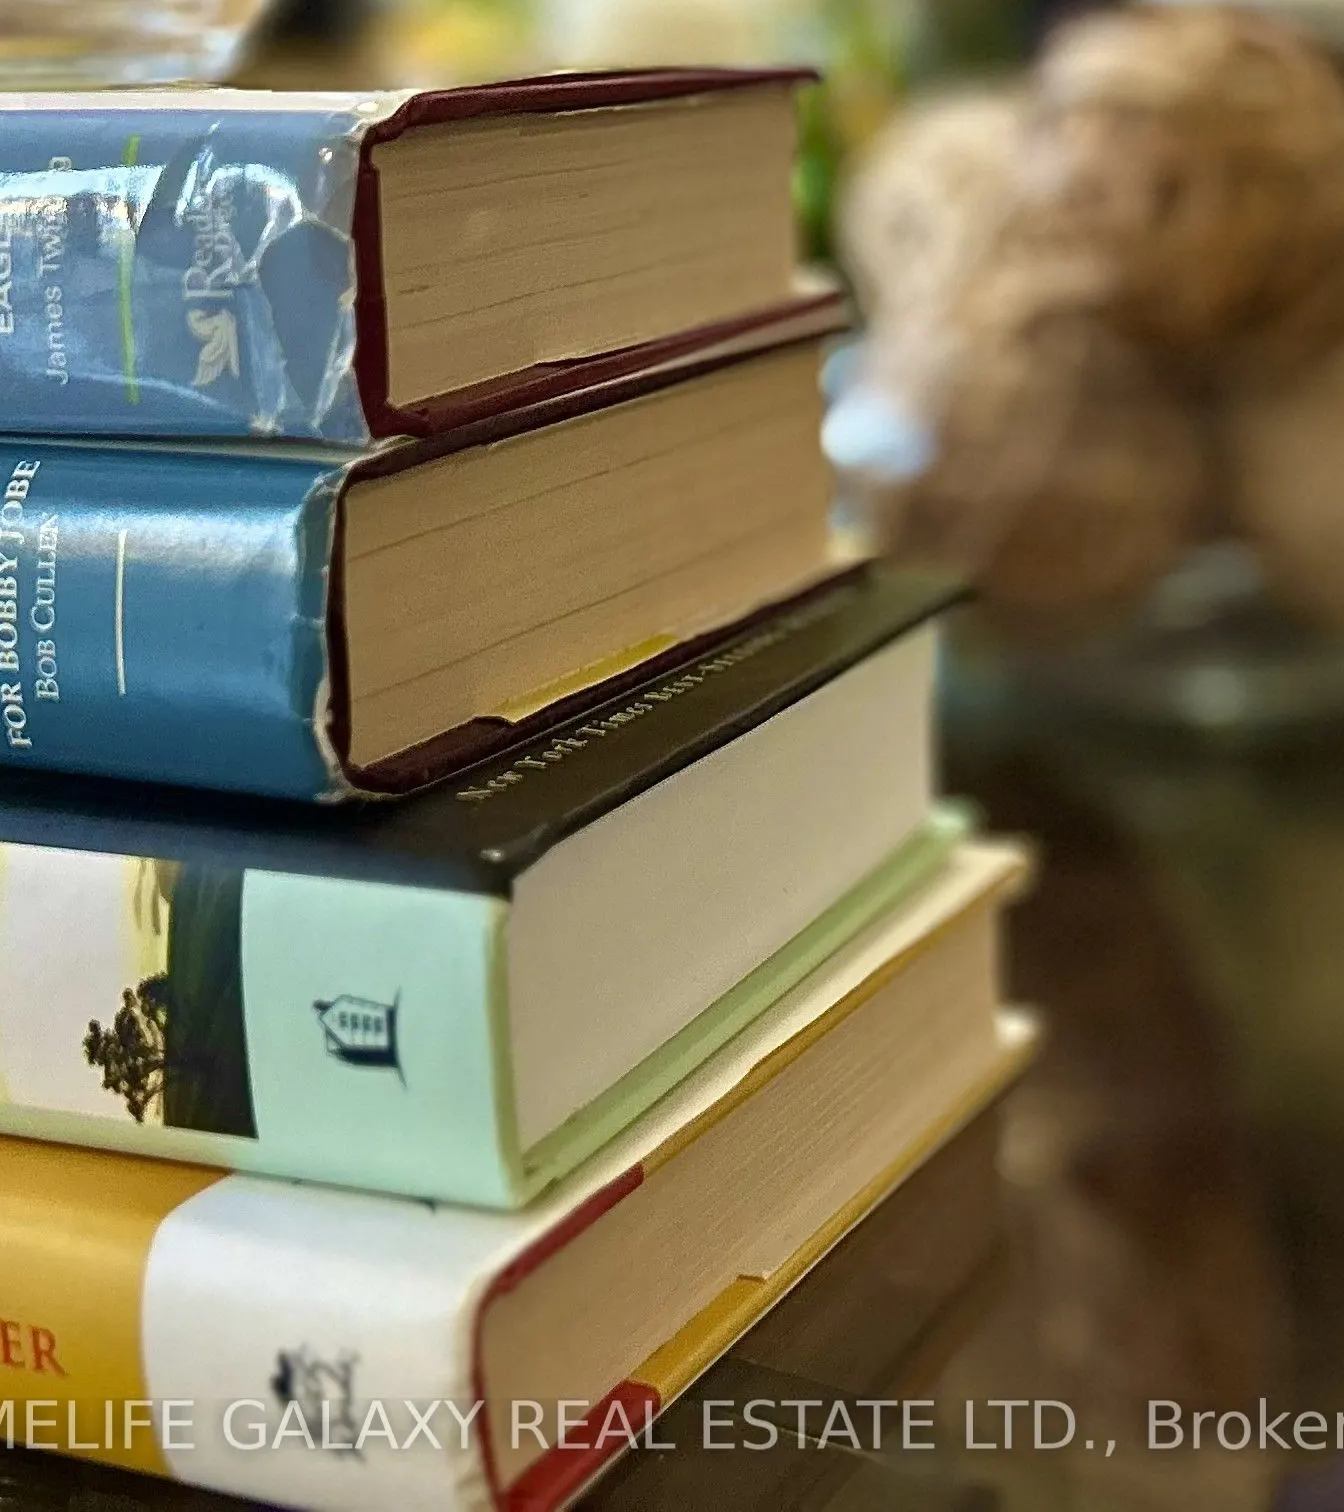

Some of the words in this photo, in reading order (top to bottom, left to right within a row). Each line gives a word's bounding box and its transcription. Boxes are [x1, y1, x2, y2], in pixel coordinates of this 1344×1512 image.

[46, 284, 70, 385] James
[30, 512, 60, 633] CULLEN
[33, 638, 60, 702] BOB
[0, 681, 34, 749] FOR
